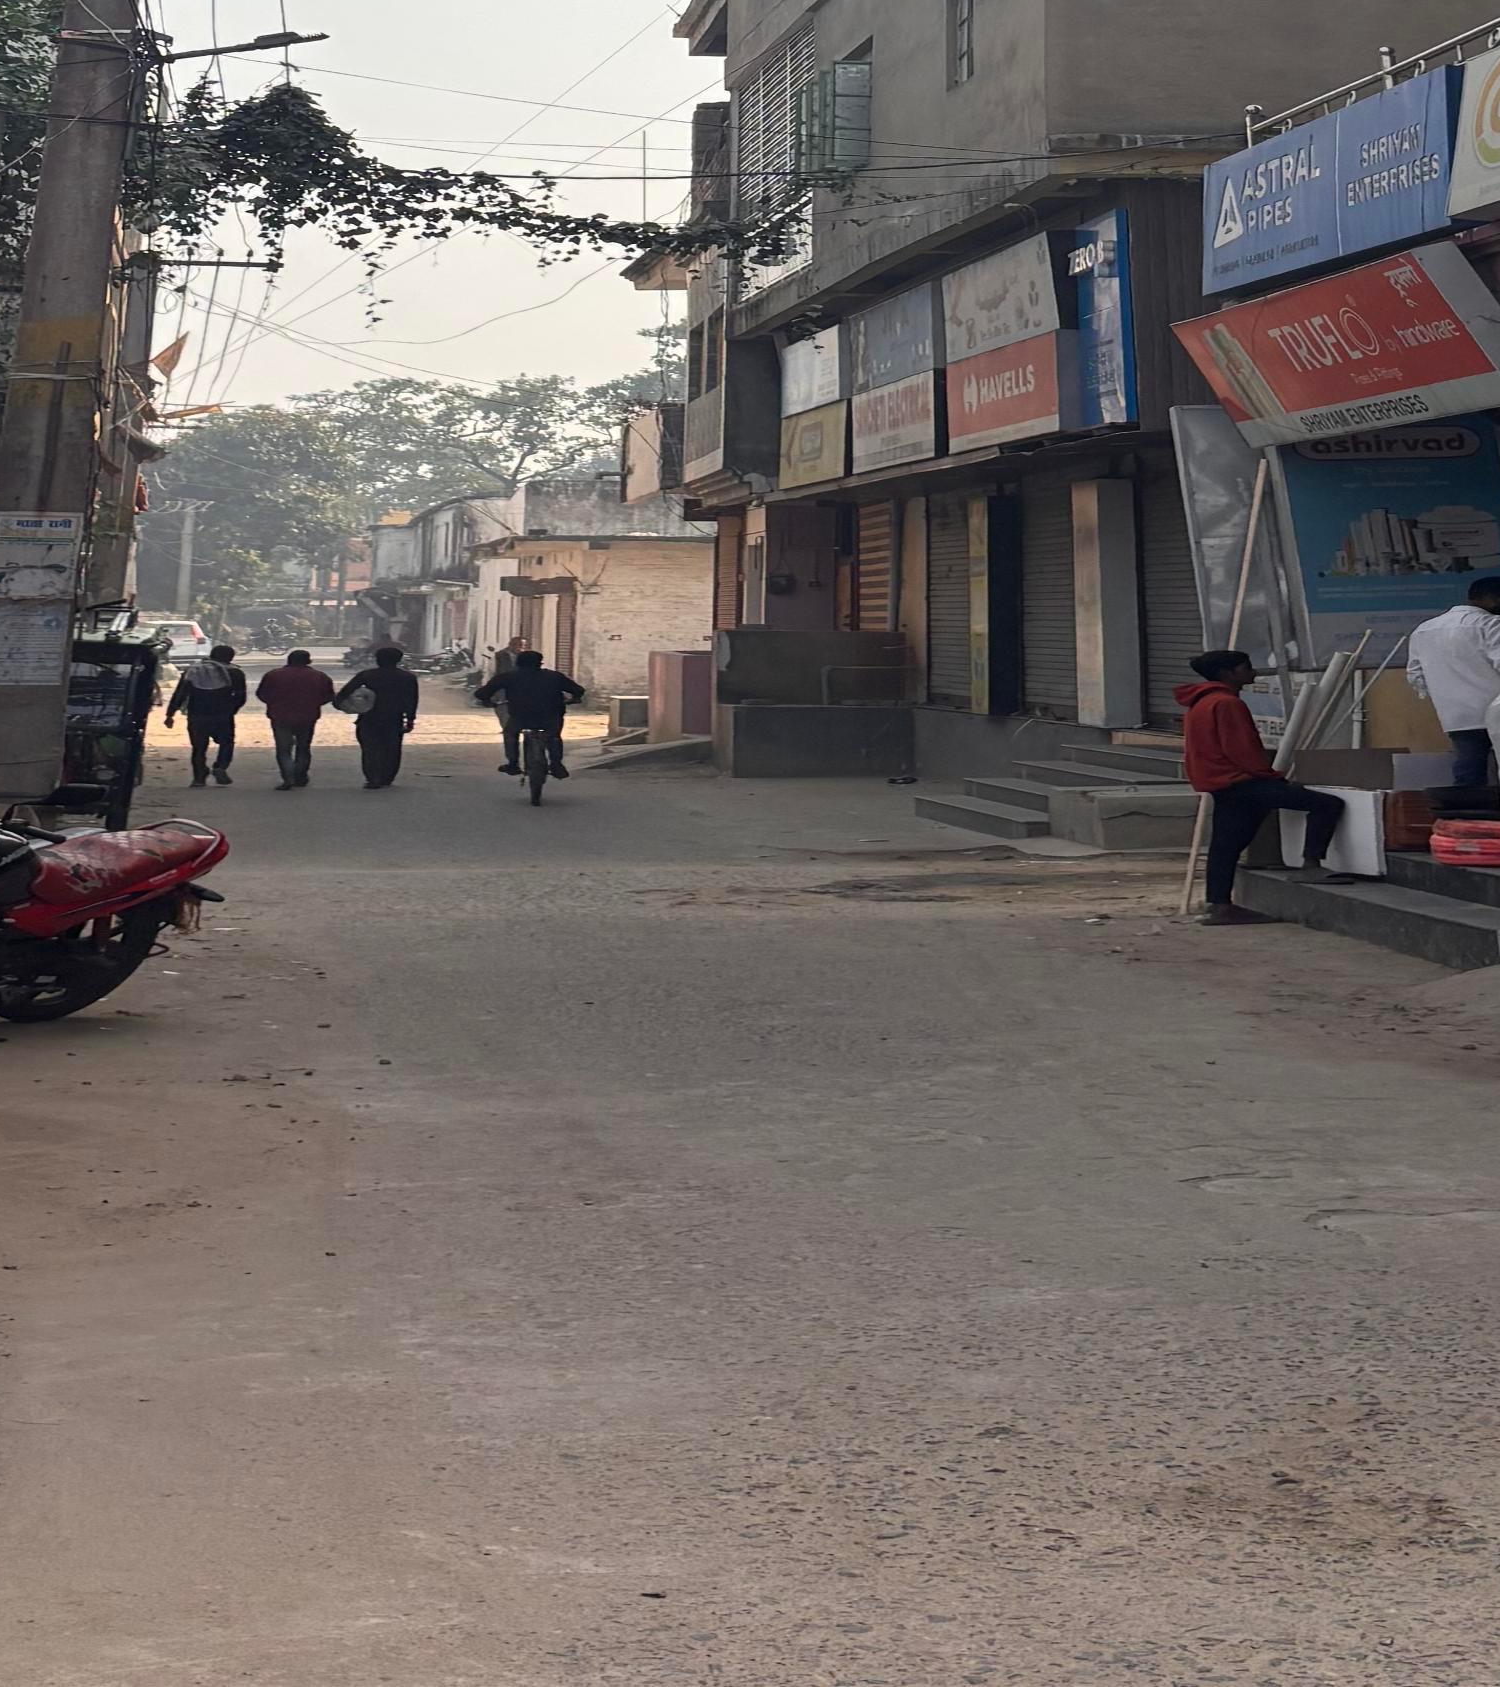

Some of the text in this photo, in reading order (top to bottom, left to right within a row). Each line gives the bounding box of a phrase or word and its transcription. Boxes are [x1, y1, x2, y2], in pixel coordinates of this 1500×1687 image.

[1241, 145, 1321, 205] ASTRAL
[1346, 153, 1440, 207] ENTERPRISES
[1245, 196, 1293, 234] PIPES
[1268, 307, 1380, 372] TRUFLO
[1391, 319, 1460, 348] hindware
[980, 364, 1035, 405] HAVELLS
[1300, 394, 1431, 435] SHRIYAM ENTERPRISES
[1310, 432, 1466, 455] ashirvad
